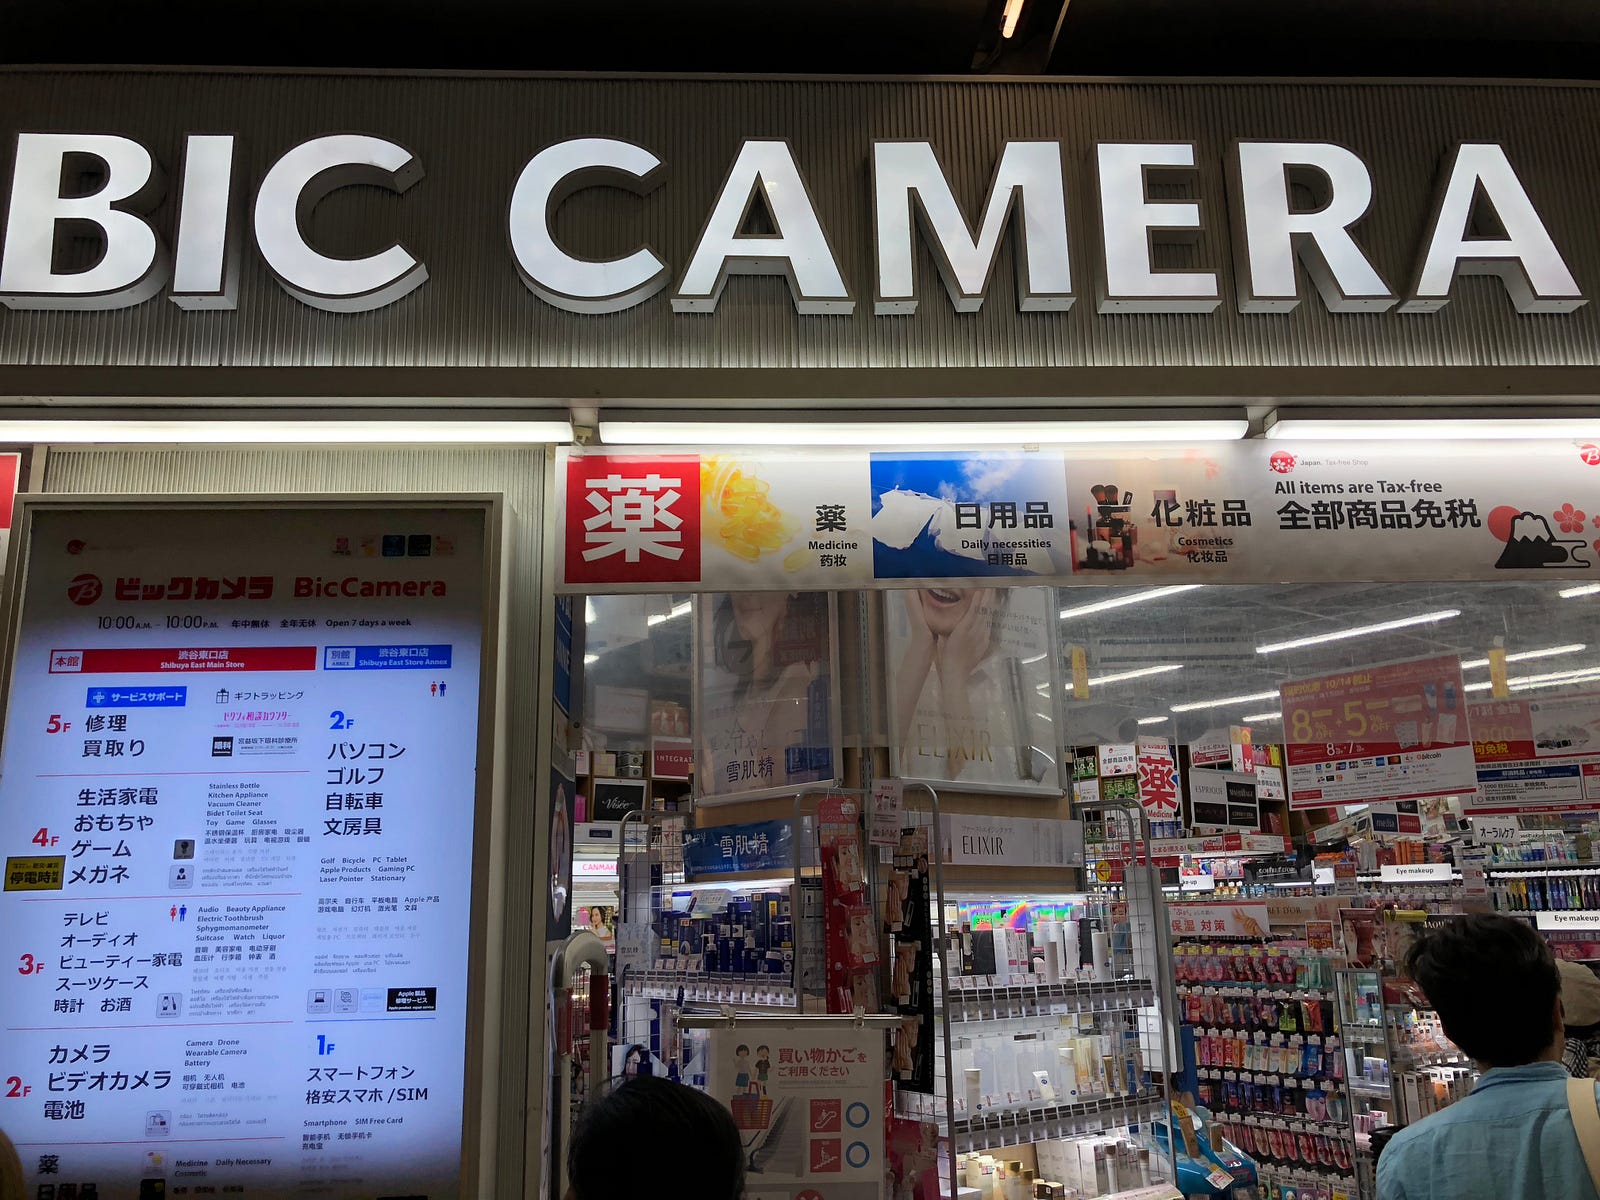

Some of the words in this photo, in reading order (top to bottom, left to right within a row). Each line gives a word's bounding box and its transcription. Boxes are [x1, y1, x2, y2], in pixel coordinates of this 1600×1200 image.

[1, 133, 424, 304] BIC
[508, 137, 1585, 308] CAMERA
[1275, 481, 1296, 494] All
[1300, 481, 1345, 494] items
[1348, 483, 1374, 494] are
[1377, 481, 1442, 494] Tax-free
[581, 474, 685, 563] 薬
[815, 504, 847, 532] 薬
[954, 501, 1054, 530] 日用品
[1151, 499, 1252, 528] 化粧品
[1276, 499, 1481, 530] 全部商品免税
[808, 540, 858, 551] Medicine
[961, 539, 989, 551] Daily
[991, 538, 1052, 551] necessities
[1178, 536, 1234, 547] Cosmetics
[820, 554, 847, 567] 药妆
[987, 553, 1028, 566] 日用品
[1186, 551, 1228, 563] 化妆品
[115, 576, 273, 601] ビックカメラ
[294, 577, 446, 597] BicCamera
[326, 619, 350, 628] Open
[351, 619, 357, 627] 7
[359, 619, 379, 628] days
[388, 619, 411, 627] week
[178, 650, 229, 660] 渋谷東口店
[379, 647, 430, 657] 渋谷東口店
[55, 656, 79, 667] 本館
[160, 661, 189, 669] Shibuya
[226, 660, 245, 668] Store
[359, 659, 387, 667] Shibuya
[112, 692, 183, 702] サービスサポート
[234, 691, 305, 701] ギフトラッピング
[46, 714, 72, 734] 5F
[85, 714, 127, 733] 修理
[329, 711, 354, 730] 2F
[82, 739, 145, 758] 買取り
[327, 741, 406, 760] パソコン
[327, 766, 384, 785] ゴルフ
[727, 756, 775, 783] 雪肌精
[1139, 756, 1177, 808] 薬
[76, 787, 158, 806] 生活家電
[326, 792, 384, 811] 自転車
[1148, 809, 1173, 819] Medicine
[74, 814, 153, 832] おもちゃ
[323, 817, 382, 836] 文房具
[32, 828, 60, 847] 4F
[1480, 827, 1515, 839] オーラルケア
[71, 840, 132, 858] ゲーム
[720, 832, 769, 858] 雪肌精
[962, 835, 1004, 855] ELIXIR
[342, 857, 366, 865] Bicycle
[68, 865, 130, 884] メガネ
[1408, 867, 1434, 875] makeup
[63, 911, 109, 927] テレビ
[1554, 915, 1568, 923] Eye
[1569, 915, 1600, 923] makeup
[196, 924, 269, 933] Sphygmomanometer
[61, 932, 138, 948] オーディオ
[18, 953, 45, 976] 3F
[60, 952, 182, 970] ビューティー家電
[55, 976, 149, 992] スーツケース
[54, 998, 84, 1013] 時計
[100, 997, 132, 1012] お酒
[185, 1049, 219, 1057] Wearable
[317, 1035, 335, 1055] 1F
[48, 1044, 111, 1064] カメラ
[778, 1047, 867, 1064] 買い物かごを
[184, 1060, 211, 1068] Battery
[778, 1066, 849, 1077] ご利用ください
[48, 1071, 171, 1092] ビデオカメラ
[307, 1065, 415, 1082] スマートフォン
[5, 1076, 32, 1098] 2F
[305, 1088, 382, 1105] 格安スマホ
[387, 1088, 428, 1104] /SIM
[44, 1100, 85, 1120] 電池
[304, 1119, 347, 1127] Smartphone
[37, 1154, 59, 1174] 薬
[215, 1159, 234, 1167] Daily
[235, 1158, 272, 1166] Necessary
